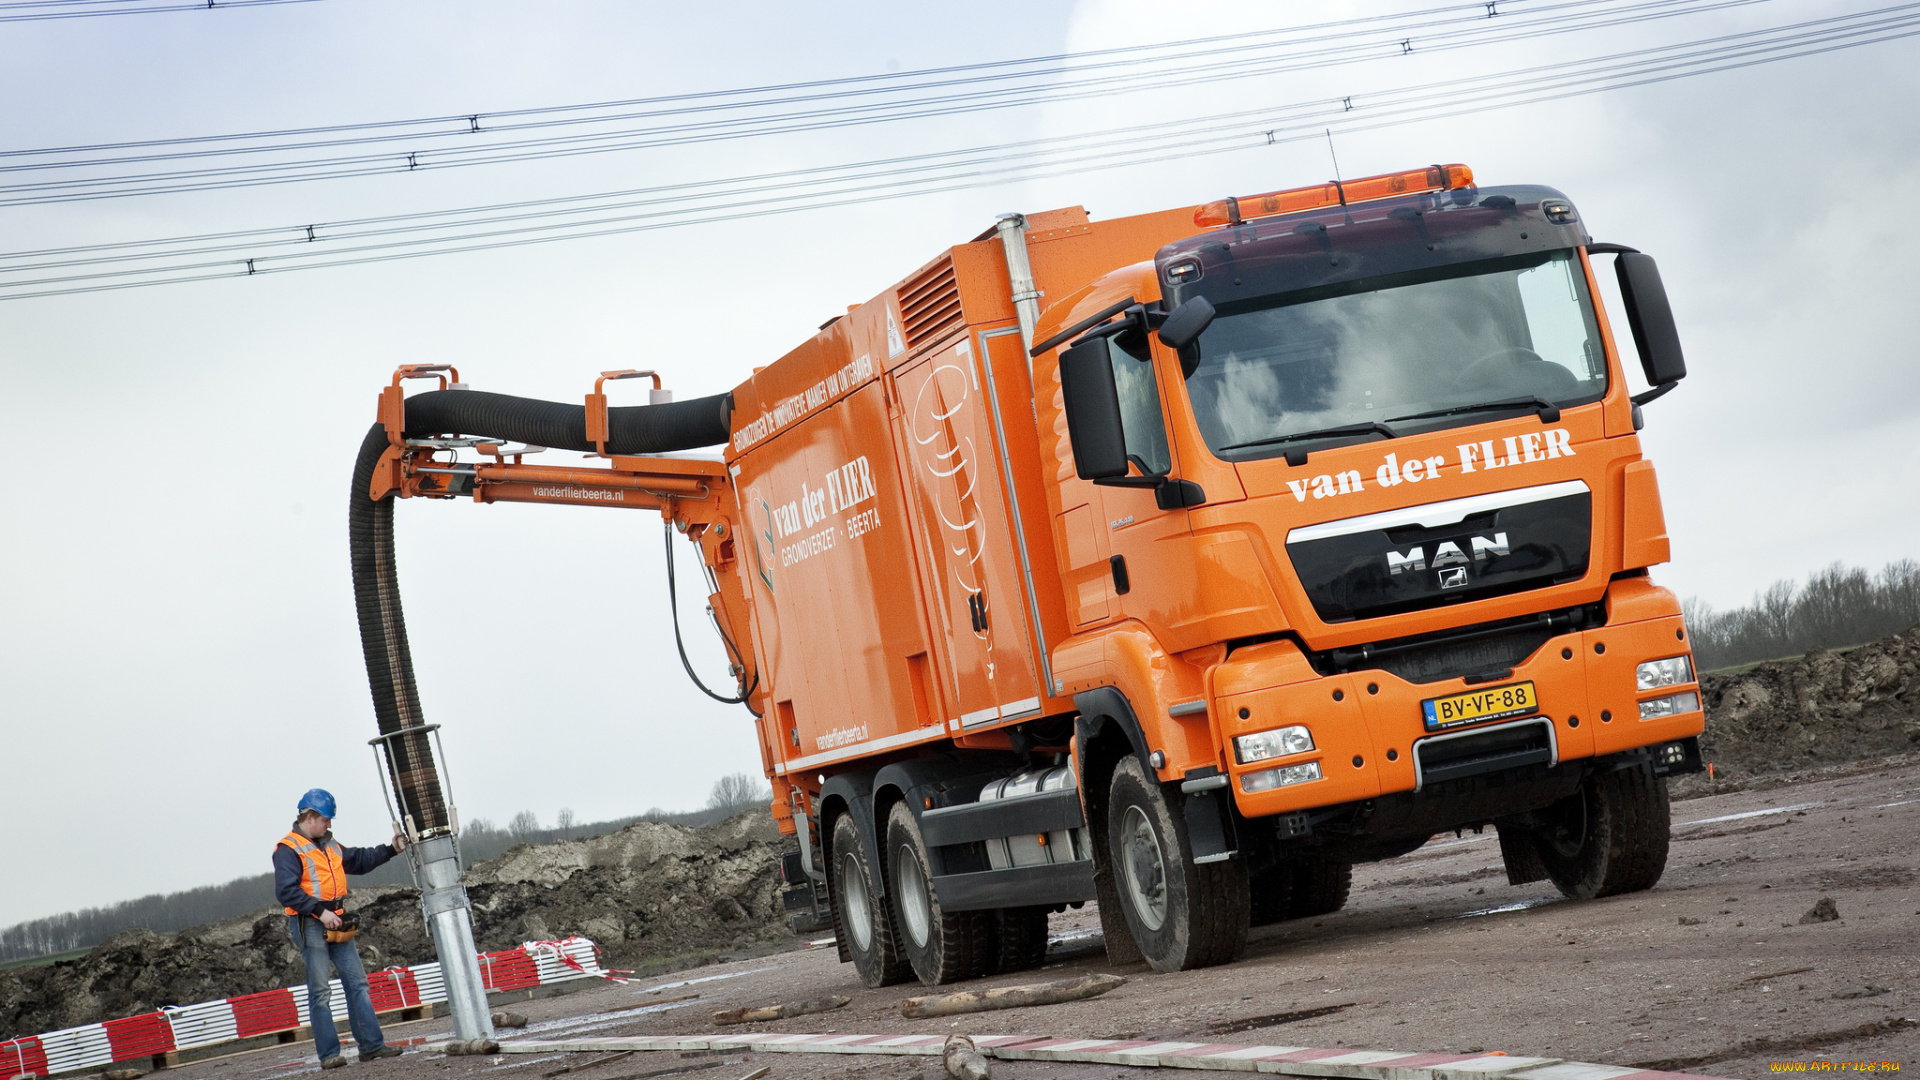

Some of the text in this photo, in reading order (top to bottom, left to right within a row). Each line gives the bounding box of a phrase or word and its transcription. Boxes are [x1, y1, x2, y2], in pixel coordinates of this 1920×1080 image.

[766, 412, 776, 434] DE
[826, 372, 840, 398] VAN
[533, 486, 624, 501] vanderflierbeerta.nl
[1286, 428, 1576, 502] van der FLIER
[773, 455, 875, 539] van der FLIER
[781, 507, 881, 567] GRONDVERZET BEERTA
[1386, 531, 1510, 575] MAN
[1441, 688, 1527, 719] BV-VF-88
